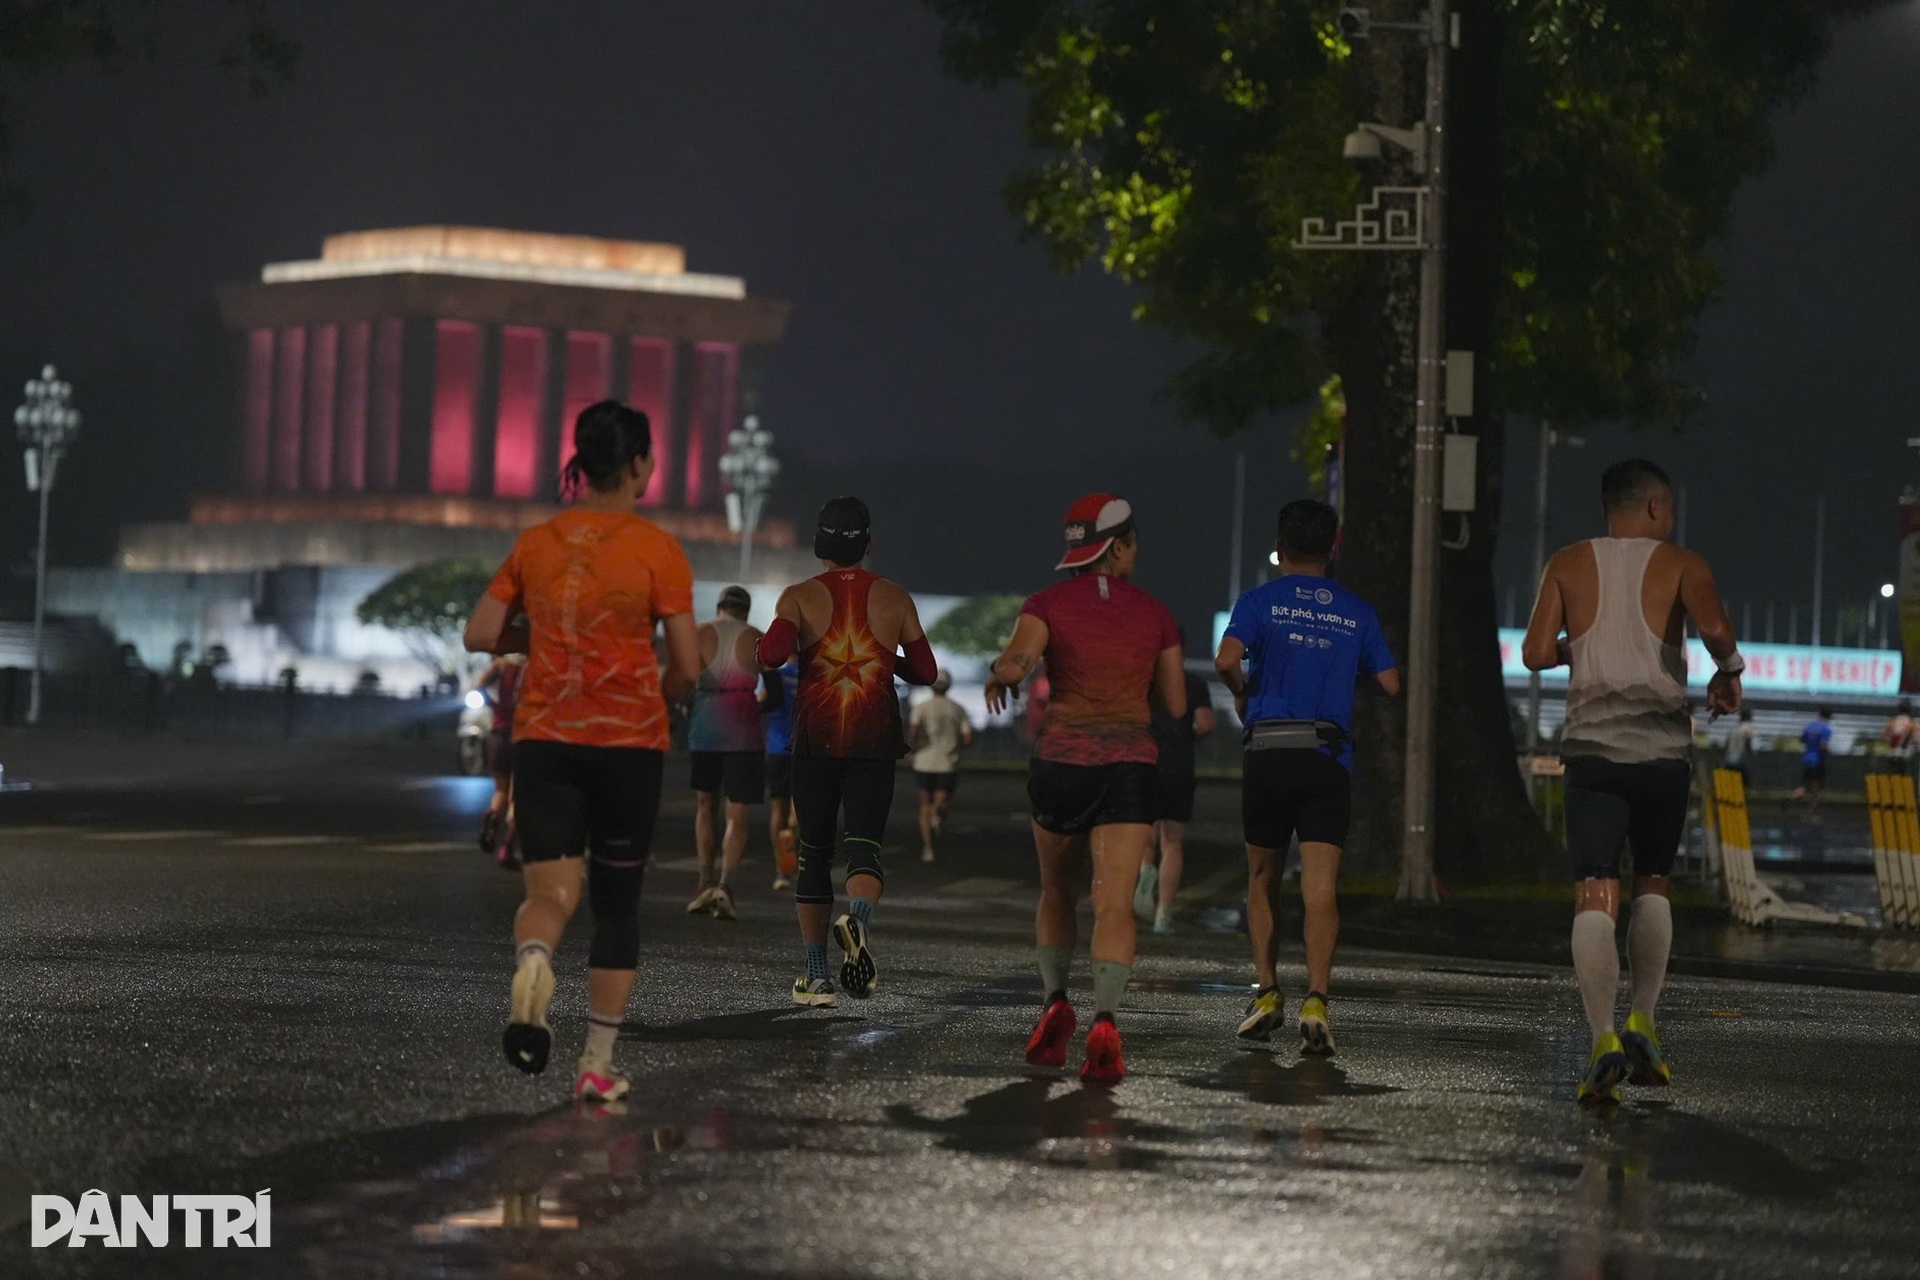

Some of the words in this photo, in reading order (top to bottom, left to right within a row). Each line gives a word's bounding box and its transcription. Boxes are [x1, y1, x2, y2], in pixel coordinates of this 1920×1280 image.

[1291, 607, 1315, 621] phá,
[1317, 612, 1342, 624] vươn
[1343, 618, 1357, 628] xa
